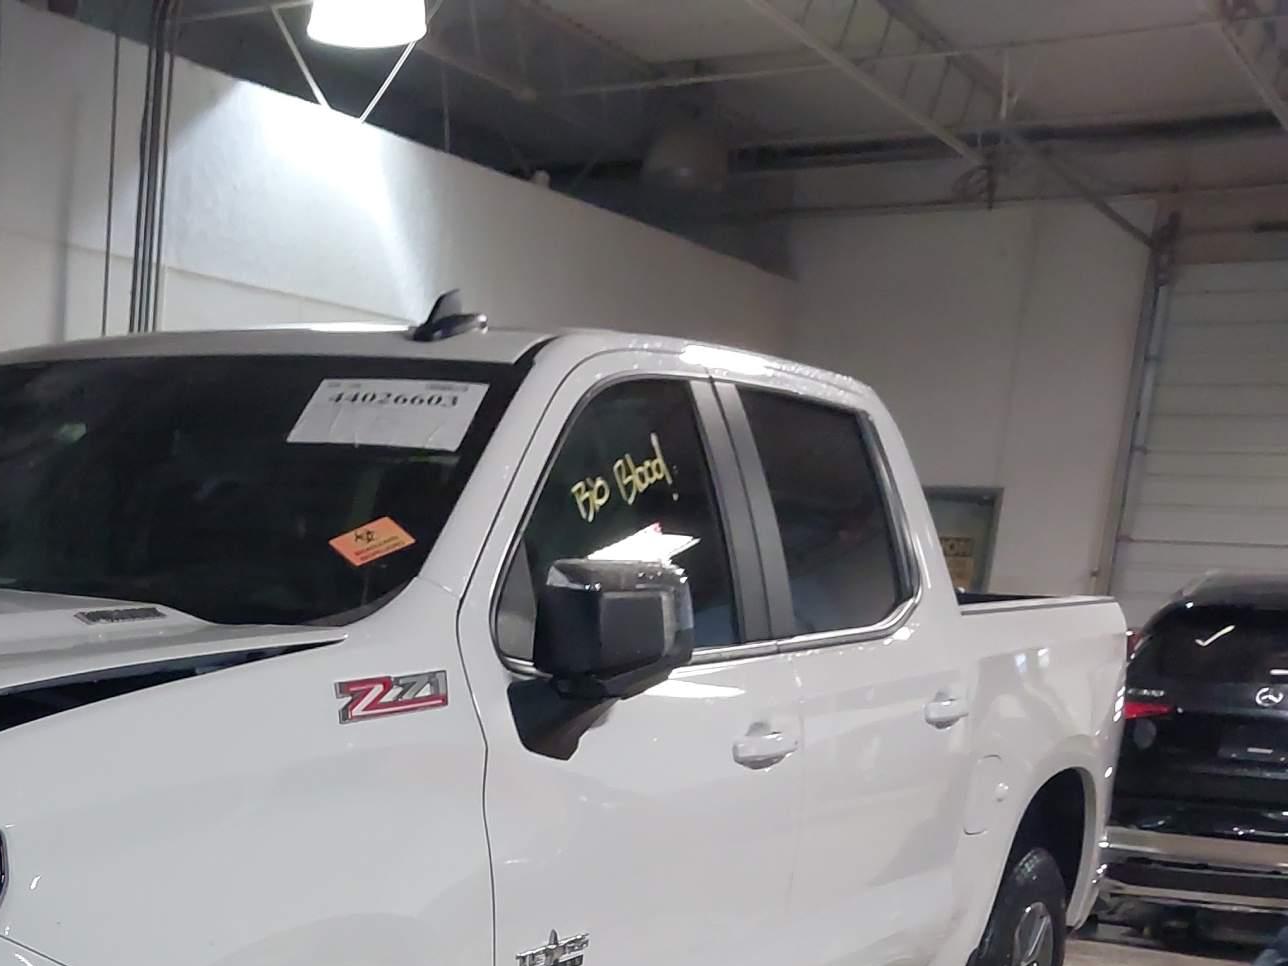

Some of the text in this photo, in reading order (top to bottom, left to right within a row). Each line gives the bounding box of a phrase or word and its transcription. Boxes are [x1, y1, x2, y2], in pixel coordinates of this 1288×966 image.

[328, 391, 459, 407] 44026603
[571, 476, 610, 523] Bio
[334, 669, 449, 725] Z71
